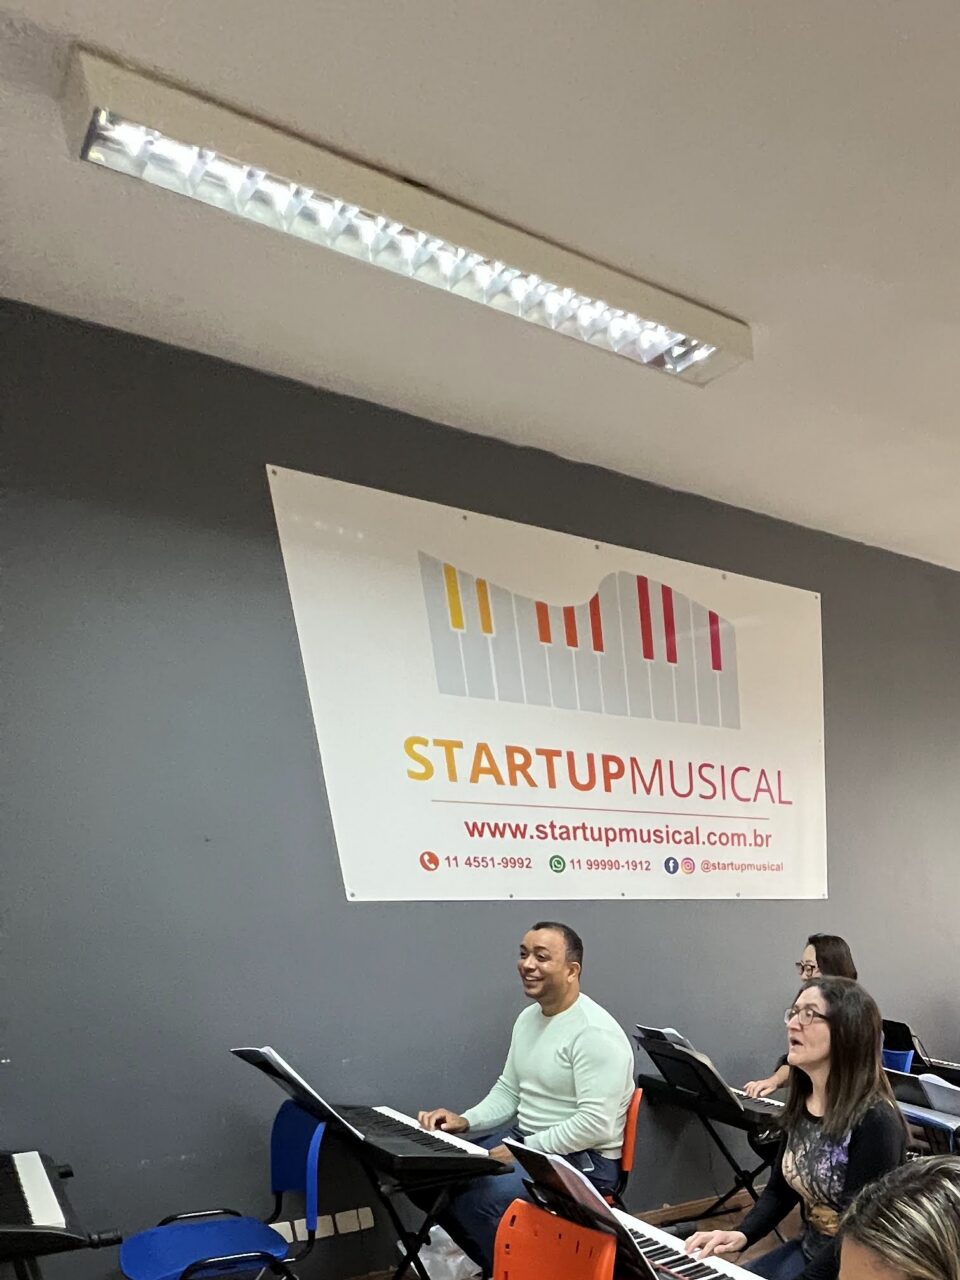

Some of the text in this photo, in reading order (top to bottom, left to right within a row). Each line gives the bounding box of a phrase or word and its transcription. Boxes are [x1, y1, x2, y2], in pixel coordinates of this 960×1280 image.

[403, 735, 793, 805] STARTUPMUSICAL
[464, 820, 772, 848] www.startupmusical.com.br
[444, 855, 532, 869] 11 4551-9992
[570, 858, 651, 871] 11 99990-1912
[700, 859, 784, 873] @startupmusical
